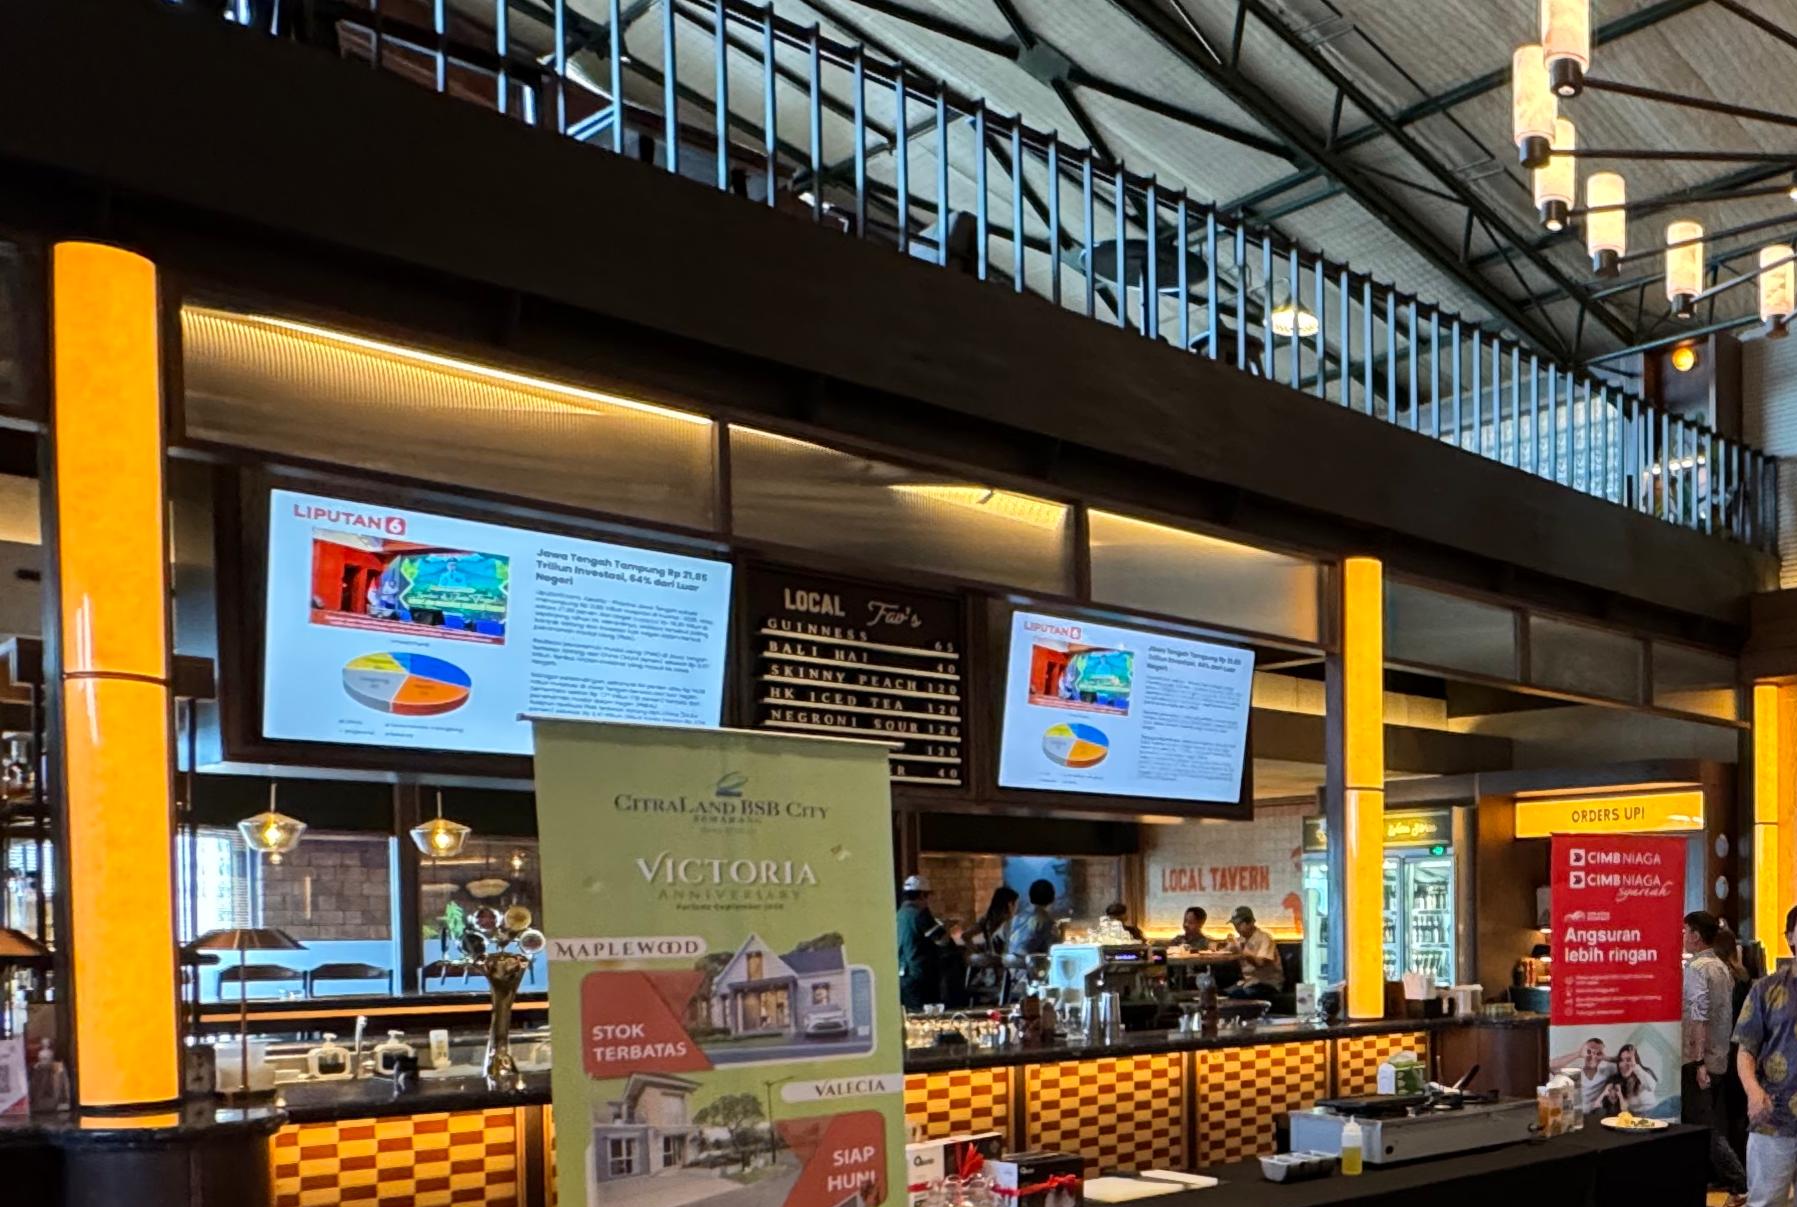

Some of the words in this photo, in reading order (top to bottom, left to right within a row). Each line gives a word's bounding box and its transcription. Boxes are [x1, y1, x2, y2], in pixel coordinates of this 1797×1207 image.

[293, 504, 382, 530] LIPUTAN
[536, 549, 568, 561] Jawa
[571, 553, 612, 568] Tengah
[615, 559, 666, 577] Tampung
[668, 568, 681, 579] Rp
[677, 581, 699, 592] Luar
[784, 588, 846, 616] LOCAL
[866, 601, 922, 628] Fav's
[768, 618, 868, 642] GUINNESS
[1024, 620, 1068, 637] LIPUTAN
[769, 640, 818, 657] BALI
[835, 651, 868, 663] HAI
[771, 664, 846, 682] SKINNY
[859, 675, 918, 691] PEACH
[928, 683, 957, 695] 120
[770, 687, 795, 700] HK
[810, 691, 857, 707] ICED
[871, 697, 903, 711] TEA
[928, 704, 958, 716] 120
[771, 710, 857, 727] NEGRONI
[874, 718, 919, 733] SOUR
[928, 724, 958, 736] 120
[741, 799, 780, 817] BSB
[1572, 807, 1620, 823] ORDERS
[1624, 805, 1645, 820] UP!
[636, 851, 817, 885] VICTORIA
[1587, 852, 1621, 864] CIMB
[1622, 853, 1661, 865] NIAGA
[1161, 868, 1206, 893] LOCAL
[1209, 865, 1270, 892] TAVERN
[1587, 874, 1621, 886] CIMB
[1622, 875, 1661, 886] NIAGA
[1565, 927, 1640, 943] Angsuran
[1565, 948, 1604, 963] lebih
[1609, 948, 1657, 965] ringan
[592, 1023, 644, 1042] STOK
[593, 1042, 687, 1064] TERBATAS
[815, 1079, 886, 1097] VALECIA
[832, 1145, 876, 1167] SIAP
